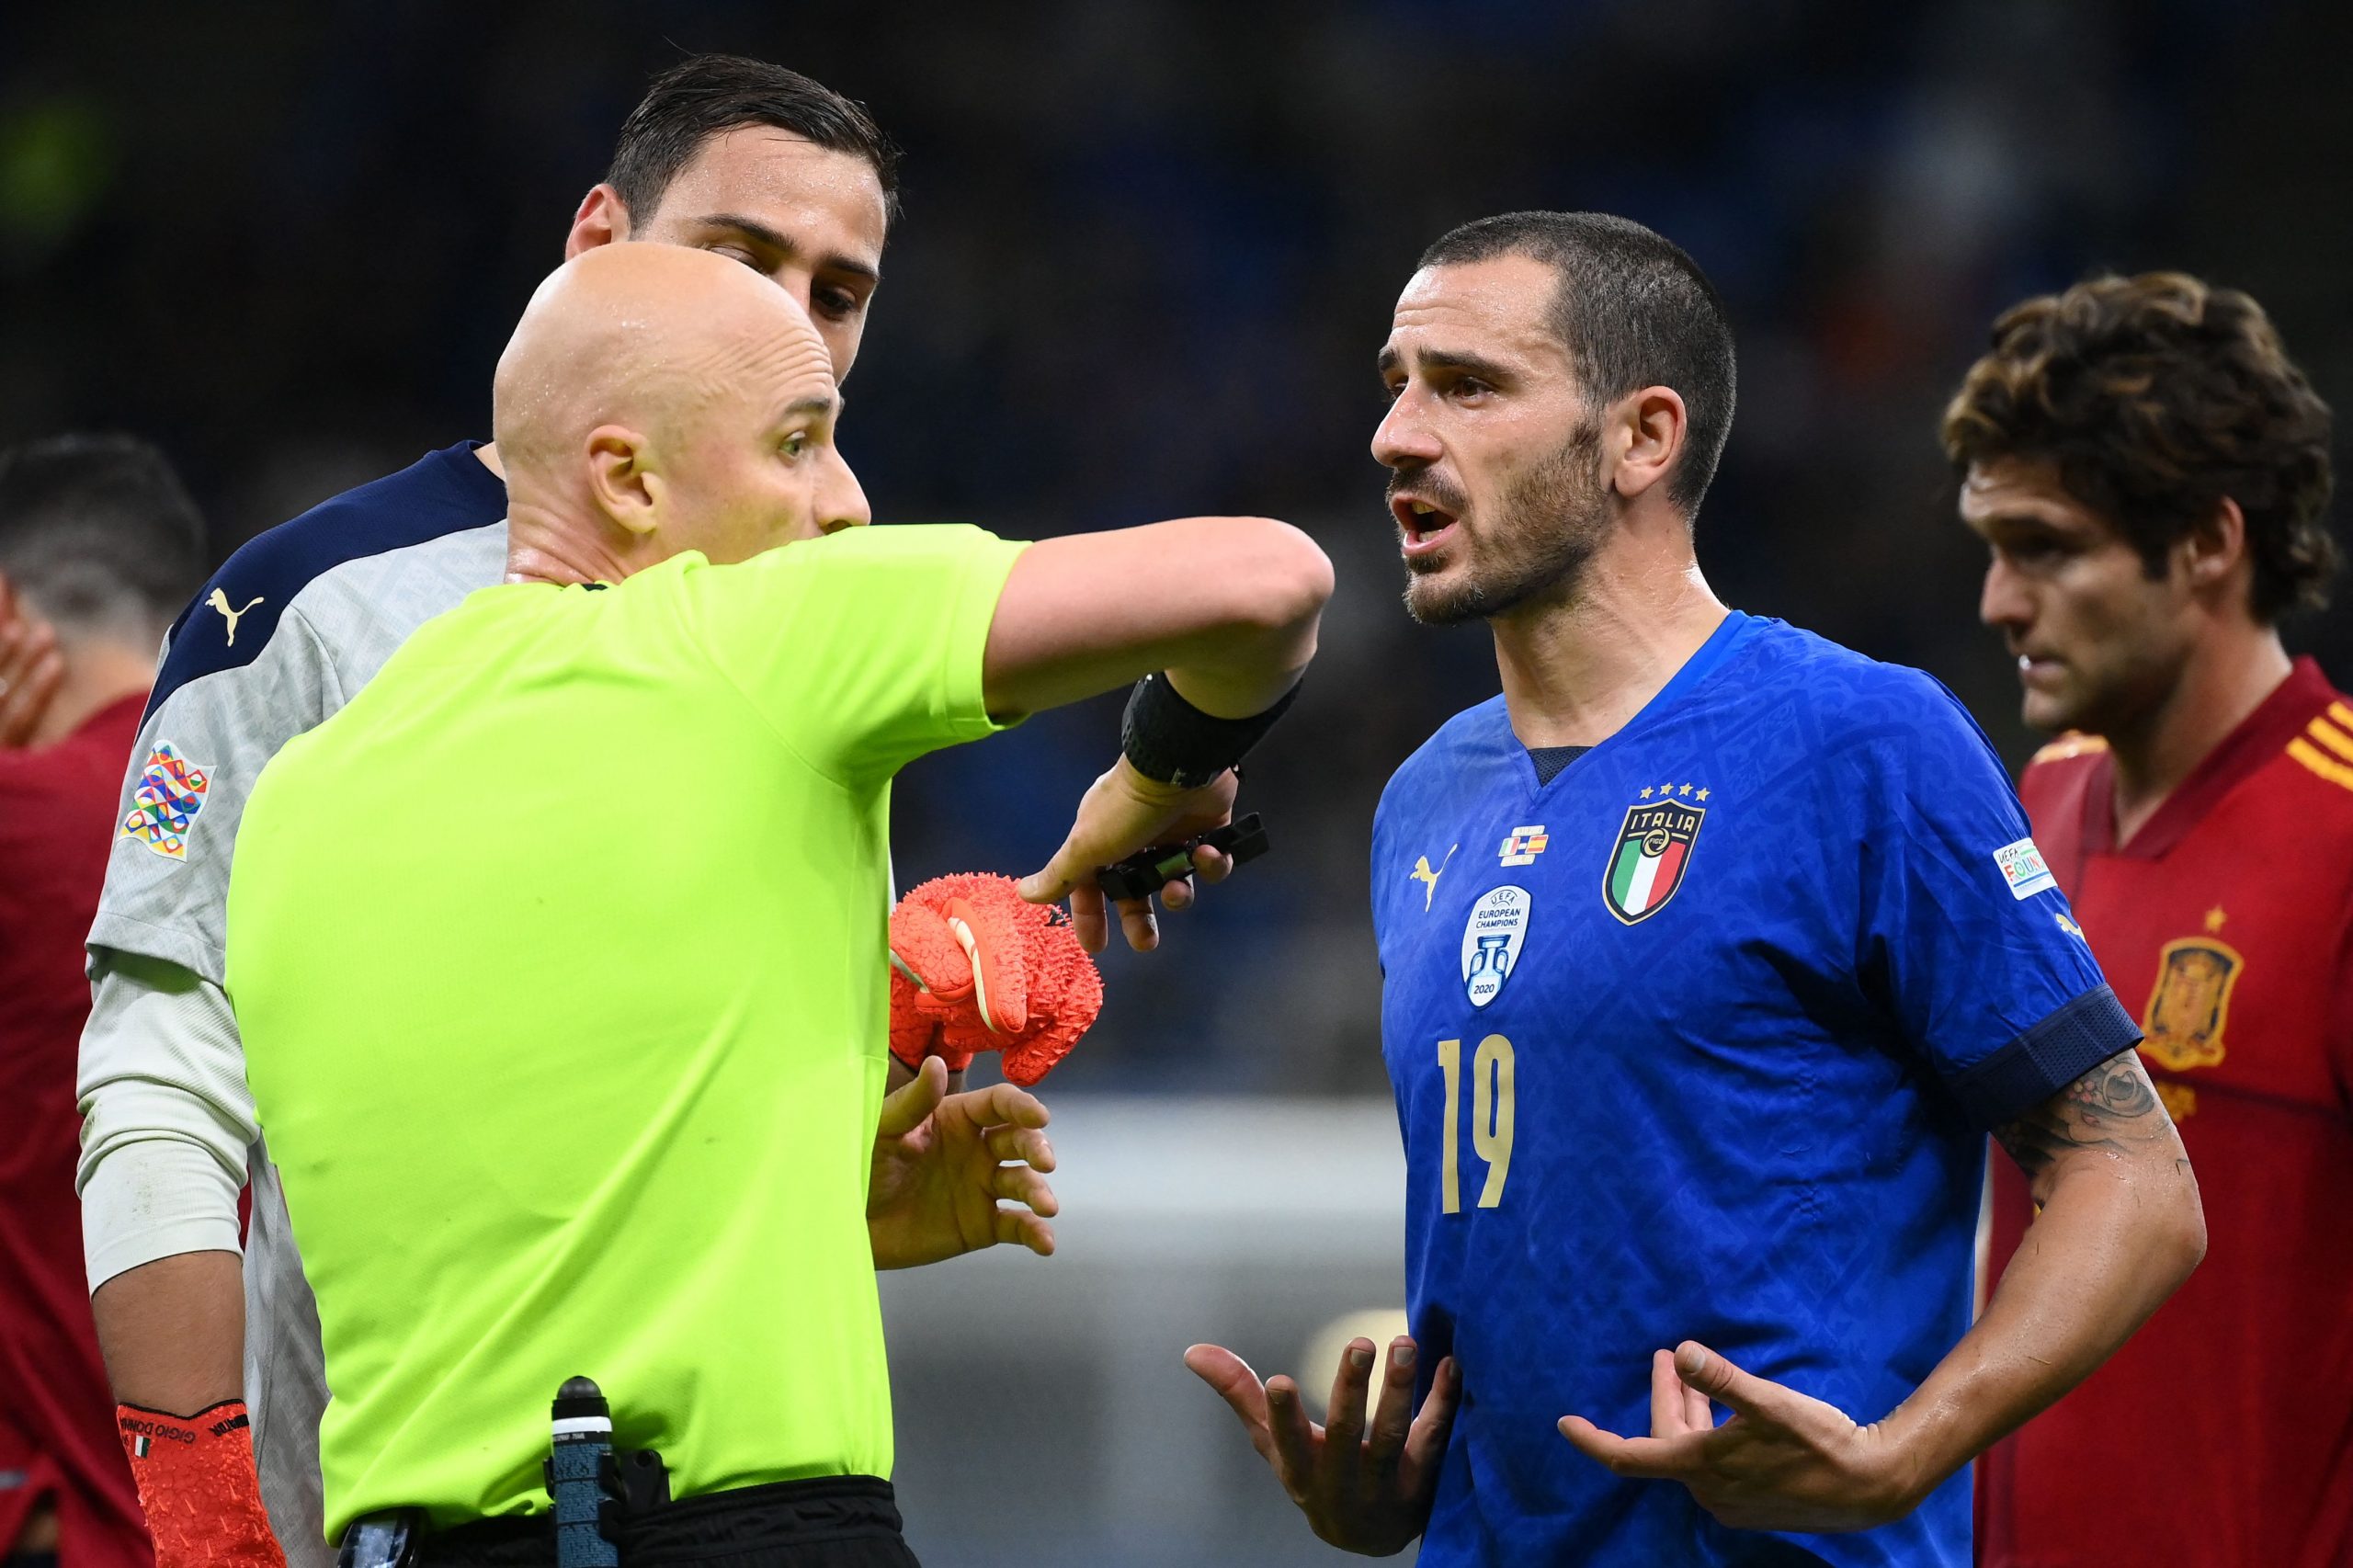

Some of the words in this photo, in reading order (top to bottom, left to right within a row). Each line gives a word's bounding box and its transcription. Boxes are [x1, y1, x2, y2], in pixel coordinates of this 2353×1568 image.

[1631, 811, 1696, 832] ITALIA
[1998, 848, 2018, 864] UEFA
[2004, 854, 2043, 882] FOUN
[1491, 889, 1515, 905] UEFA
[1478, 907, 1521, 919] EUROPEAN
[1475, 918, 1518, 929] CHAMPIONS
[1473, 983, 1495, 994] 2020
[1438, 1033, 1516, 1214] 19
[154, 1424, 196, 1444] GIGIO
